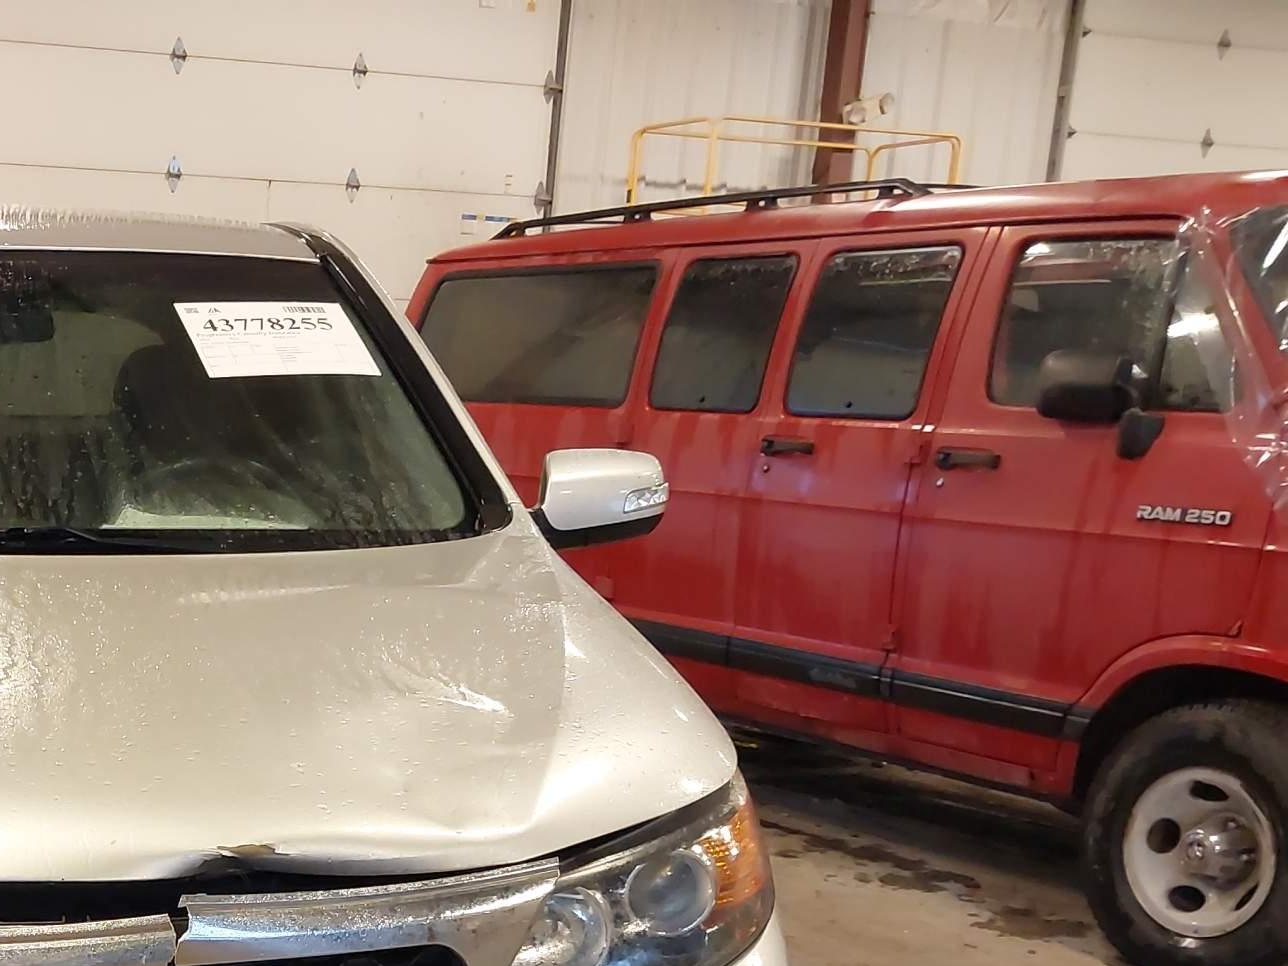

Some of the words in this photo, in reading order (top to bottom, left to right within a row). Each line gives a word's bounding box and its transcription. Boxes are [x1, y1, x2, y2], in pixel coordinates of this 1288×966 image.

[203, 318, 333, 332] 43778255
[1136, 505, 1182, 521] RAM
[1185, 508, 1232, 525] 250
